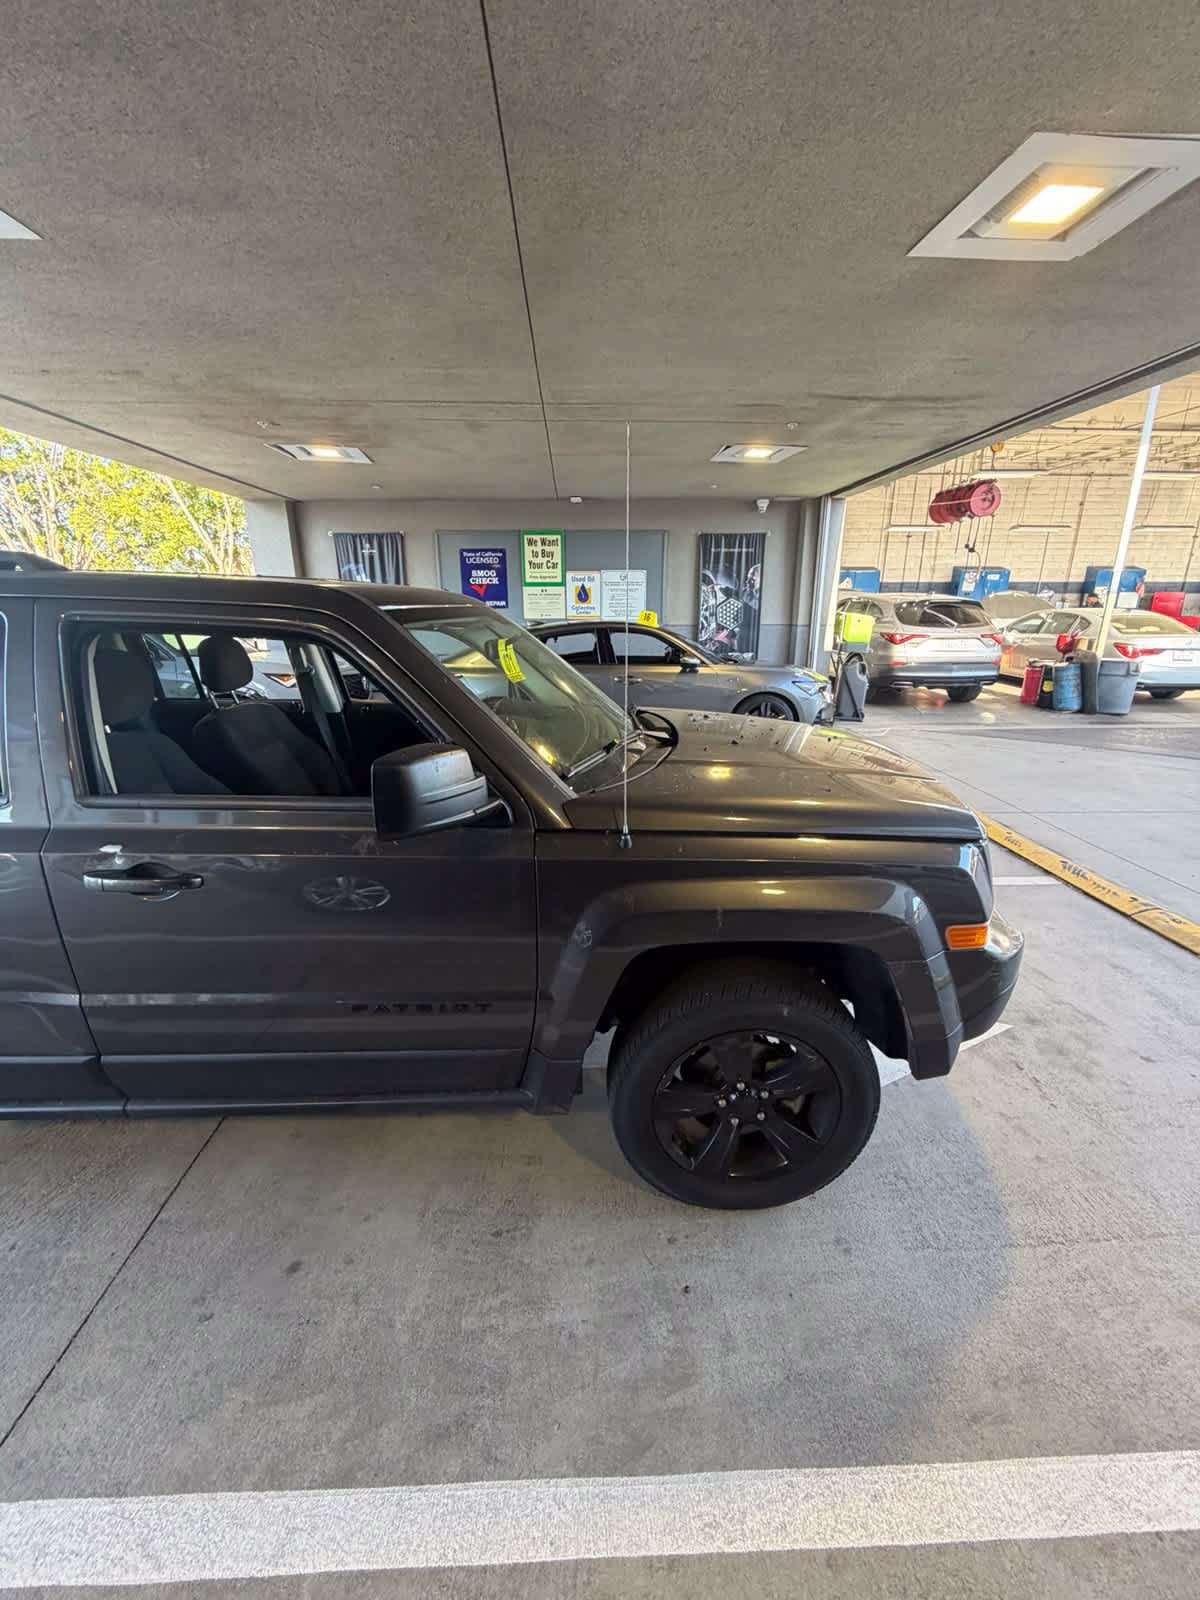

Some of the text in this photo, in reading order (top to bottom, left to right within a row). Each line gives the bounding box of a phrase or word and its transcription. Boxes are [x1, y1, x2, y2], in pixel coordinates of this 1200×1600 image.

[526, 537, 559, 547] We Want
[532, 549, 555, 560] to Buy
[528, 560, 559, 569] Your Car
[469, 577, 499, 585] CHECK
